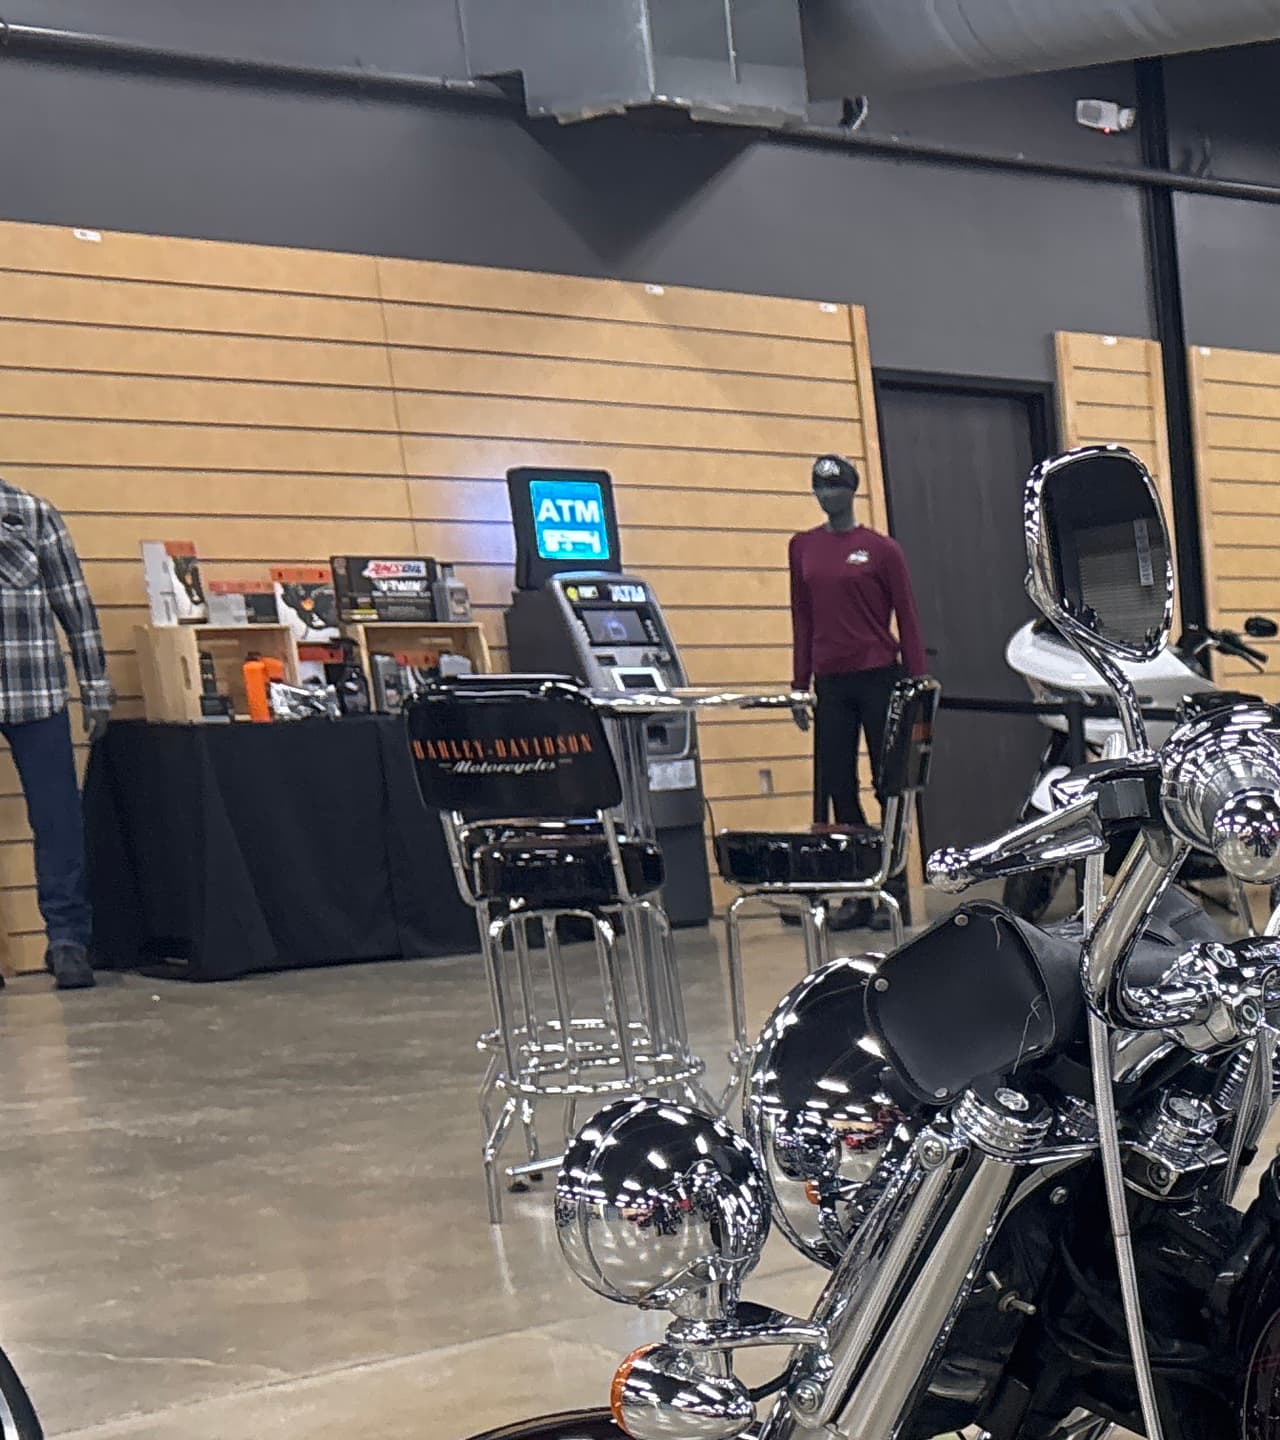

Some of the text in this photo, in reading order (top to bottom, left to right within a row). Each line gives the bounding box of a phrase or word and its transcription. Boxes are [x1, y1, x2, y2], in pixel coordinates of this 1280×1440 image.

[537, 498, 600, 524] ATM
[412, 733, 593, 761] HARLEY-DAVIDSON
[452, 757, 556, 775] Motorcycles
